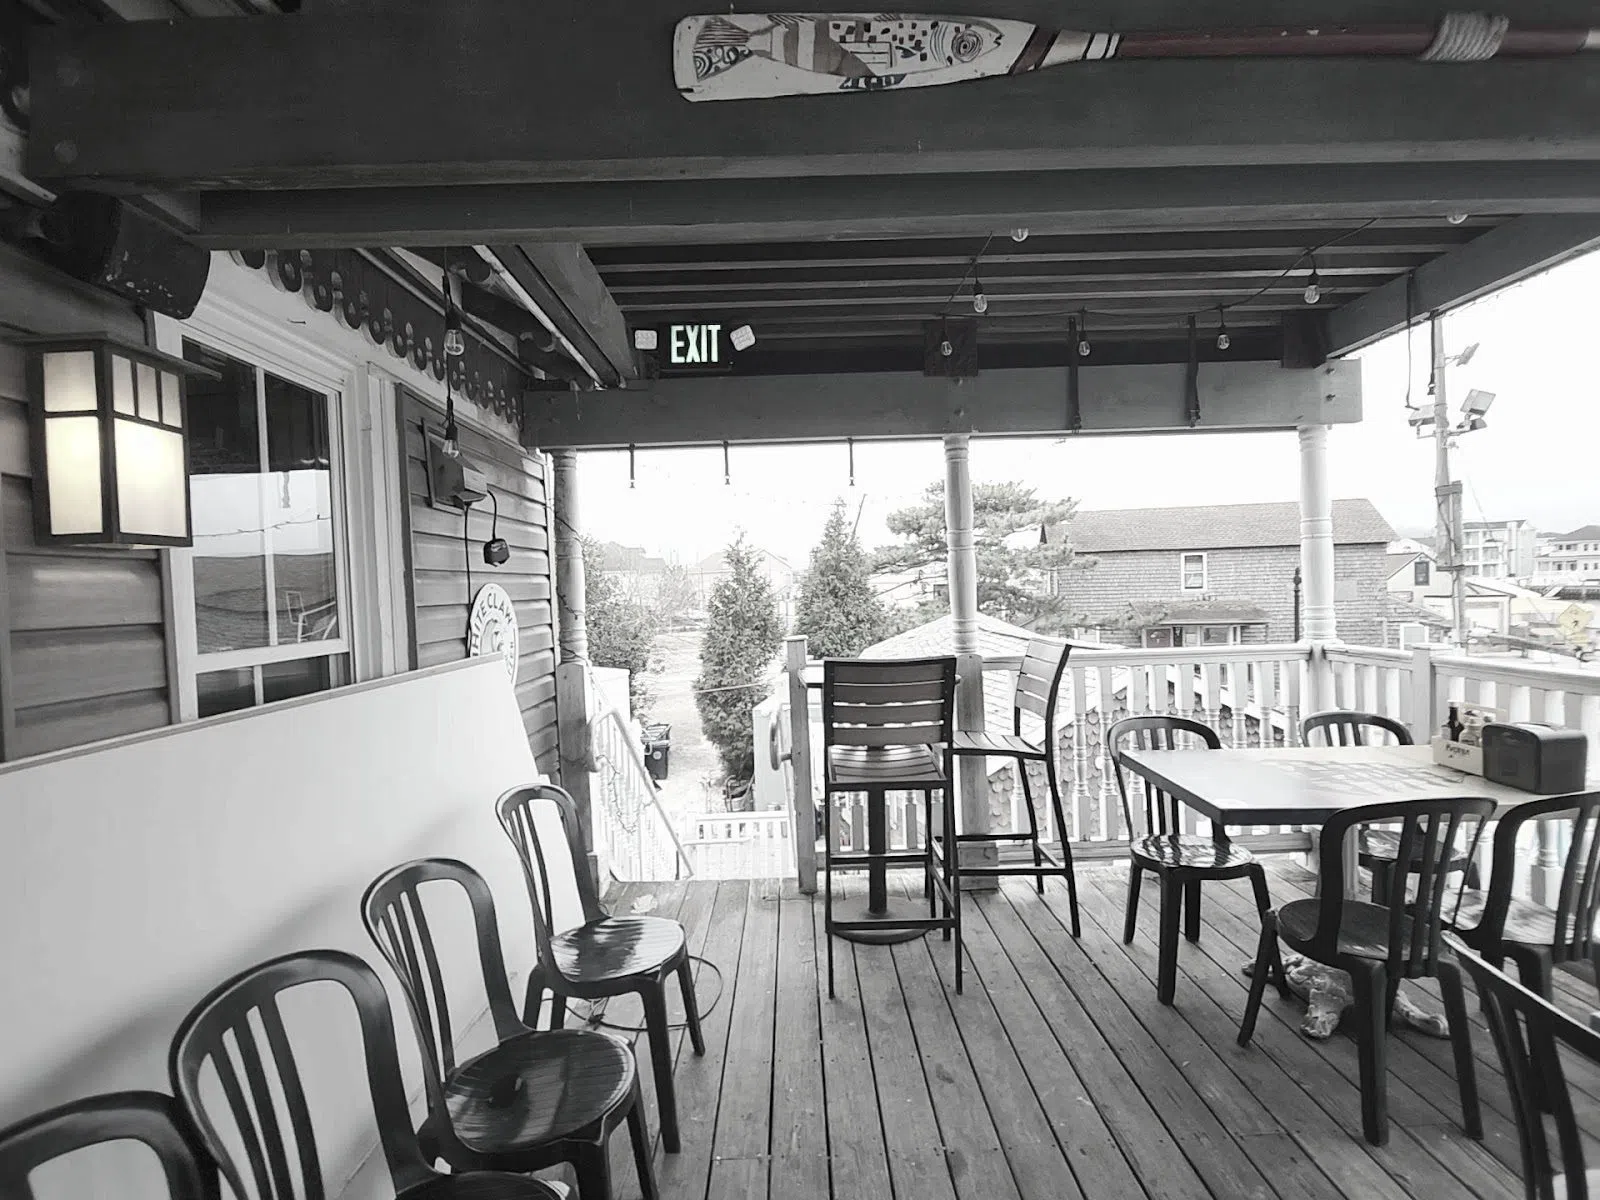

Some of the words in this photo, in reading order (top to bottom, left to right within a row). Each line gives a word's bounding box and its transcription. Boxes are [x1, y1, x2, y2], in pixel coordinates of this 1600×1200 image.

[670, 324, 721, 363] EXIT
[471, 600, 487, 657] HITE
[486, 592, 513, 624] CLAW
